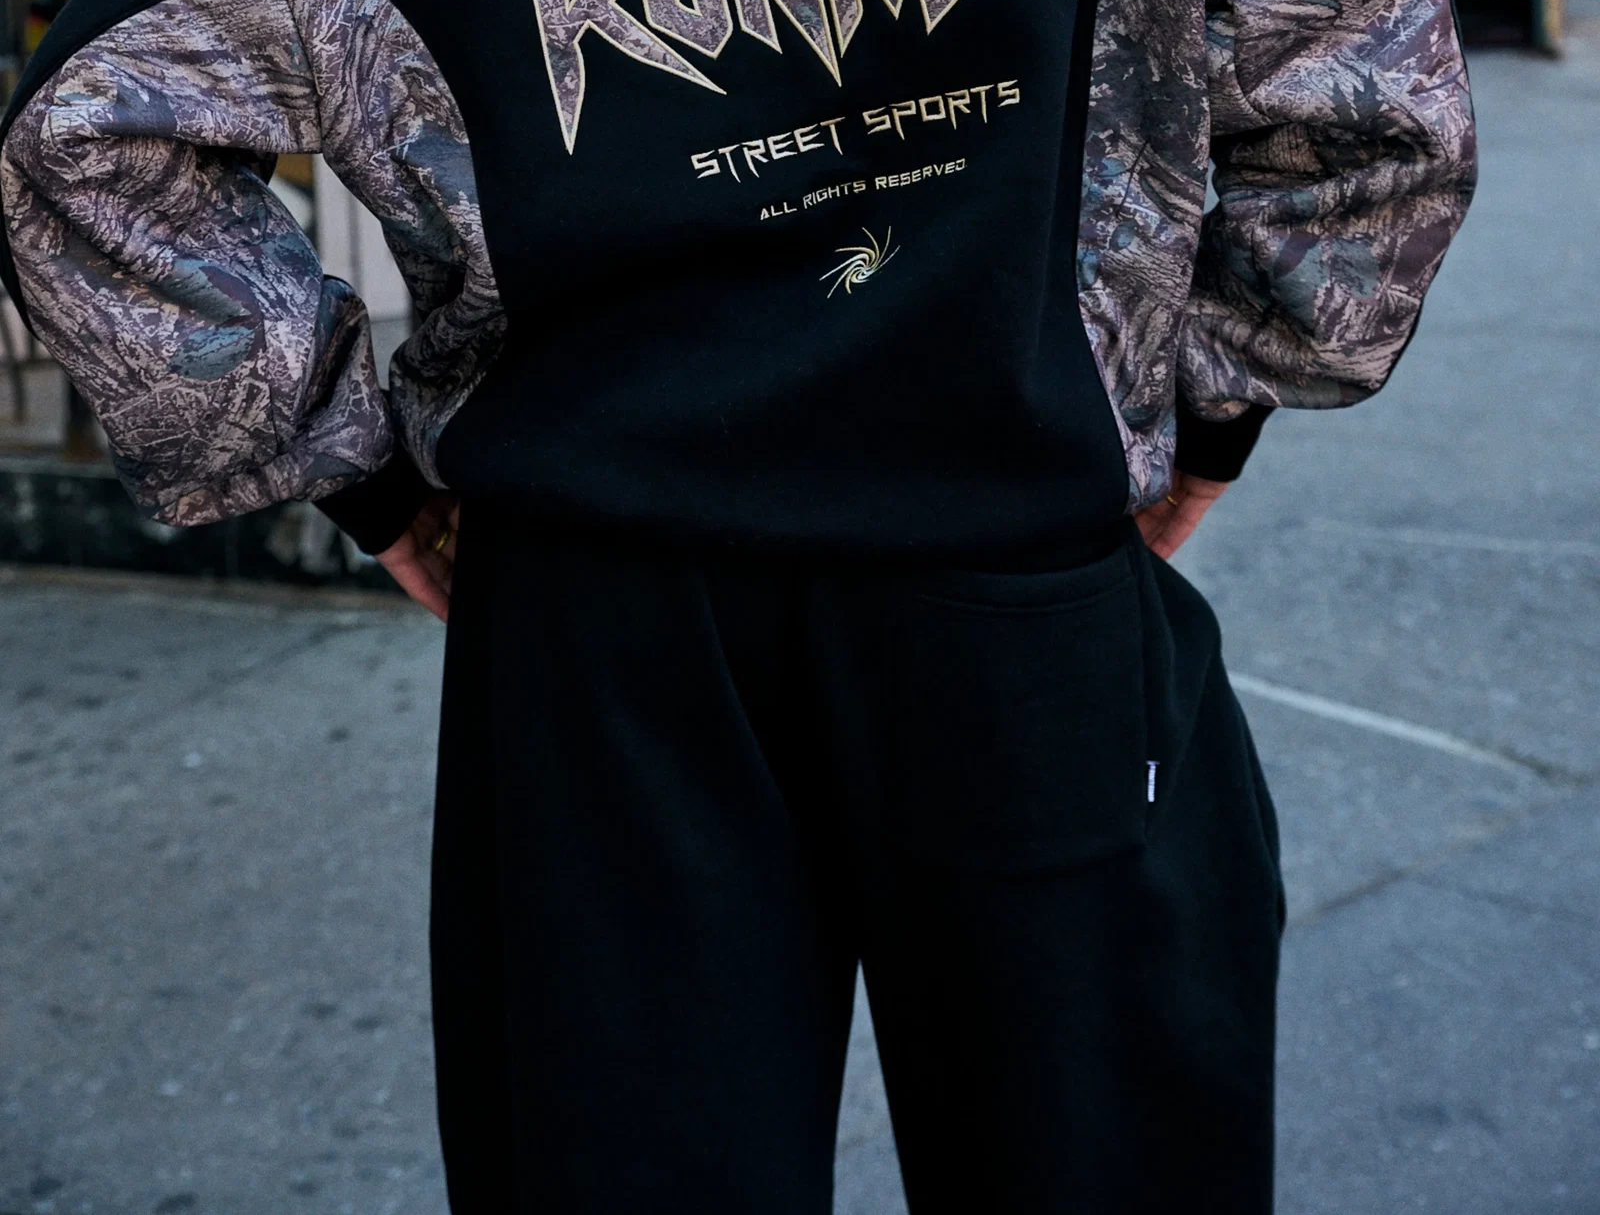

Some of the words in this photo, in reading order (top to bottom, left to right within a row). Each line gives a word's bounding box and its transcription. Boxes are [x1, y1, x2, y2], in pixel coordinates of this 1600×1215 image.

[690, 116, 846, 183] STREET
[862, 79, 1020, 141] SPORTS
[760, 202, 797, 220] ALL
[803, 180, 866, 209] RIGHTS
[875, 158, 967, 190] RESERVED
